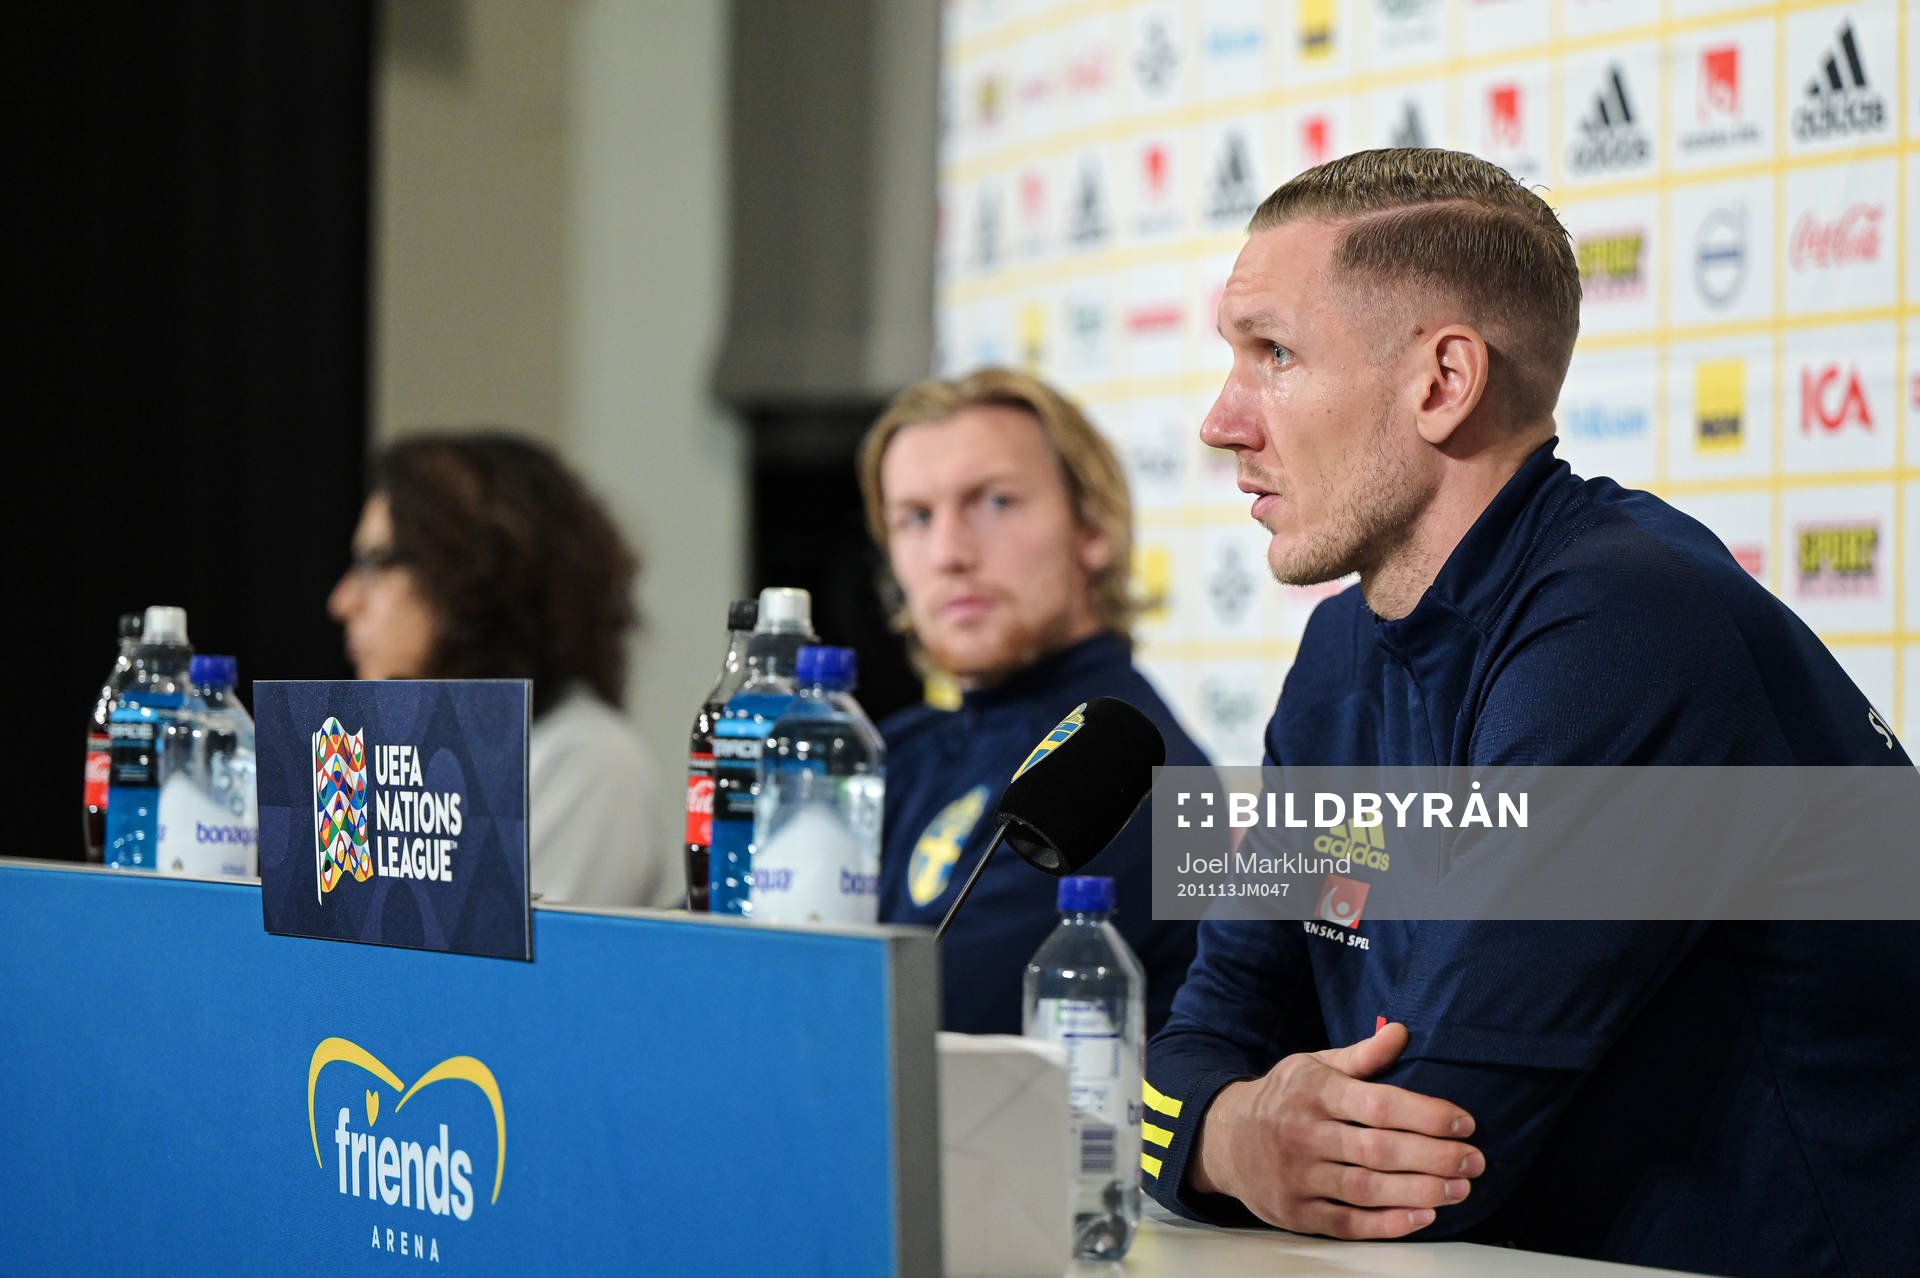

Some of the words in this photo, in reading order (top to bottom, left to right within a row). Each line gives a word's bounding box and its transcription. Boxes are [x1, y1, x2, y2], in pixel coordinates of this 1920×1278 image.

[1801, 365, 1875, 434] ICA
[375, 744, 423, 787] UEFA
[376, 790, 463, 837] NATIONS
[1314, 834, 1390, 872] adidas
[1347, 934, 1370, 950] SPEL
[335, 1106, 474, 1221] friends
[371, 1225, 440, 1263] ARENA
